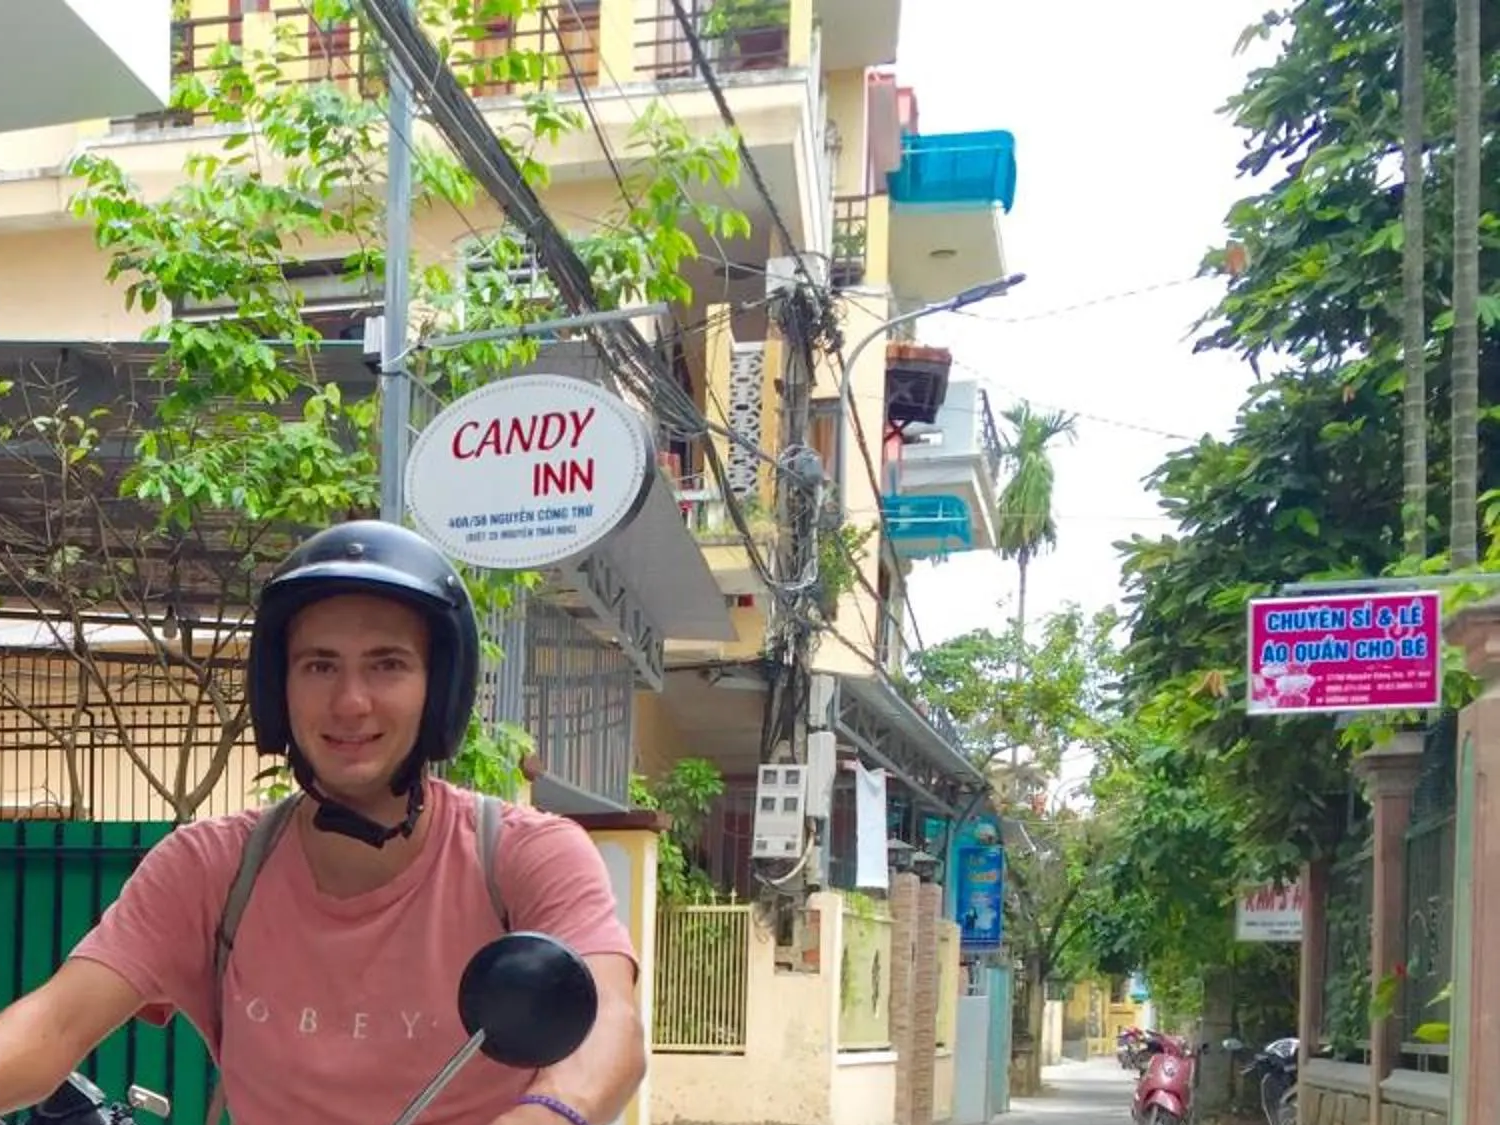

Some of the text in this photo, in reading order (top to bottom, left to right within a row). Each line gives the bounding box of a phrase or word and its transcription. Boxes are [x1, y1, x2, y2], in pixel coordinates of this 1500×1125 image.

[452, 407, 595, 460] CANDY
[533, 458, 594, 496] INN
[1266, 605, 1346, 632] CHUYÊN
[1377, 606, 1393, 627] &
[1354, 637, 1396, 660] CHO
[1401, 632, 1428, 659] BÉ
[246, 998, 420, 1039] OBEY
